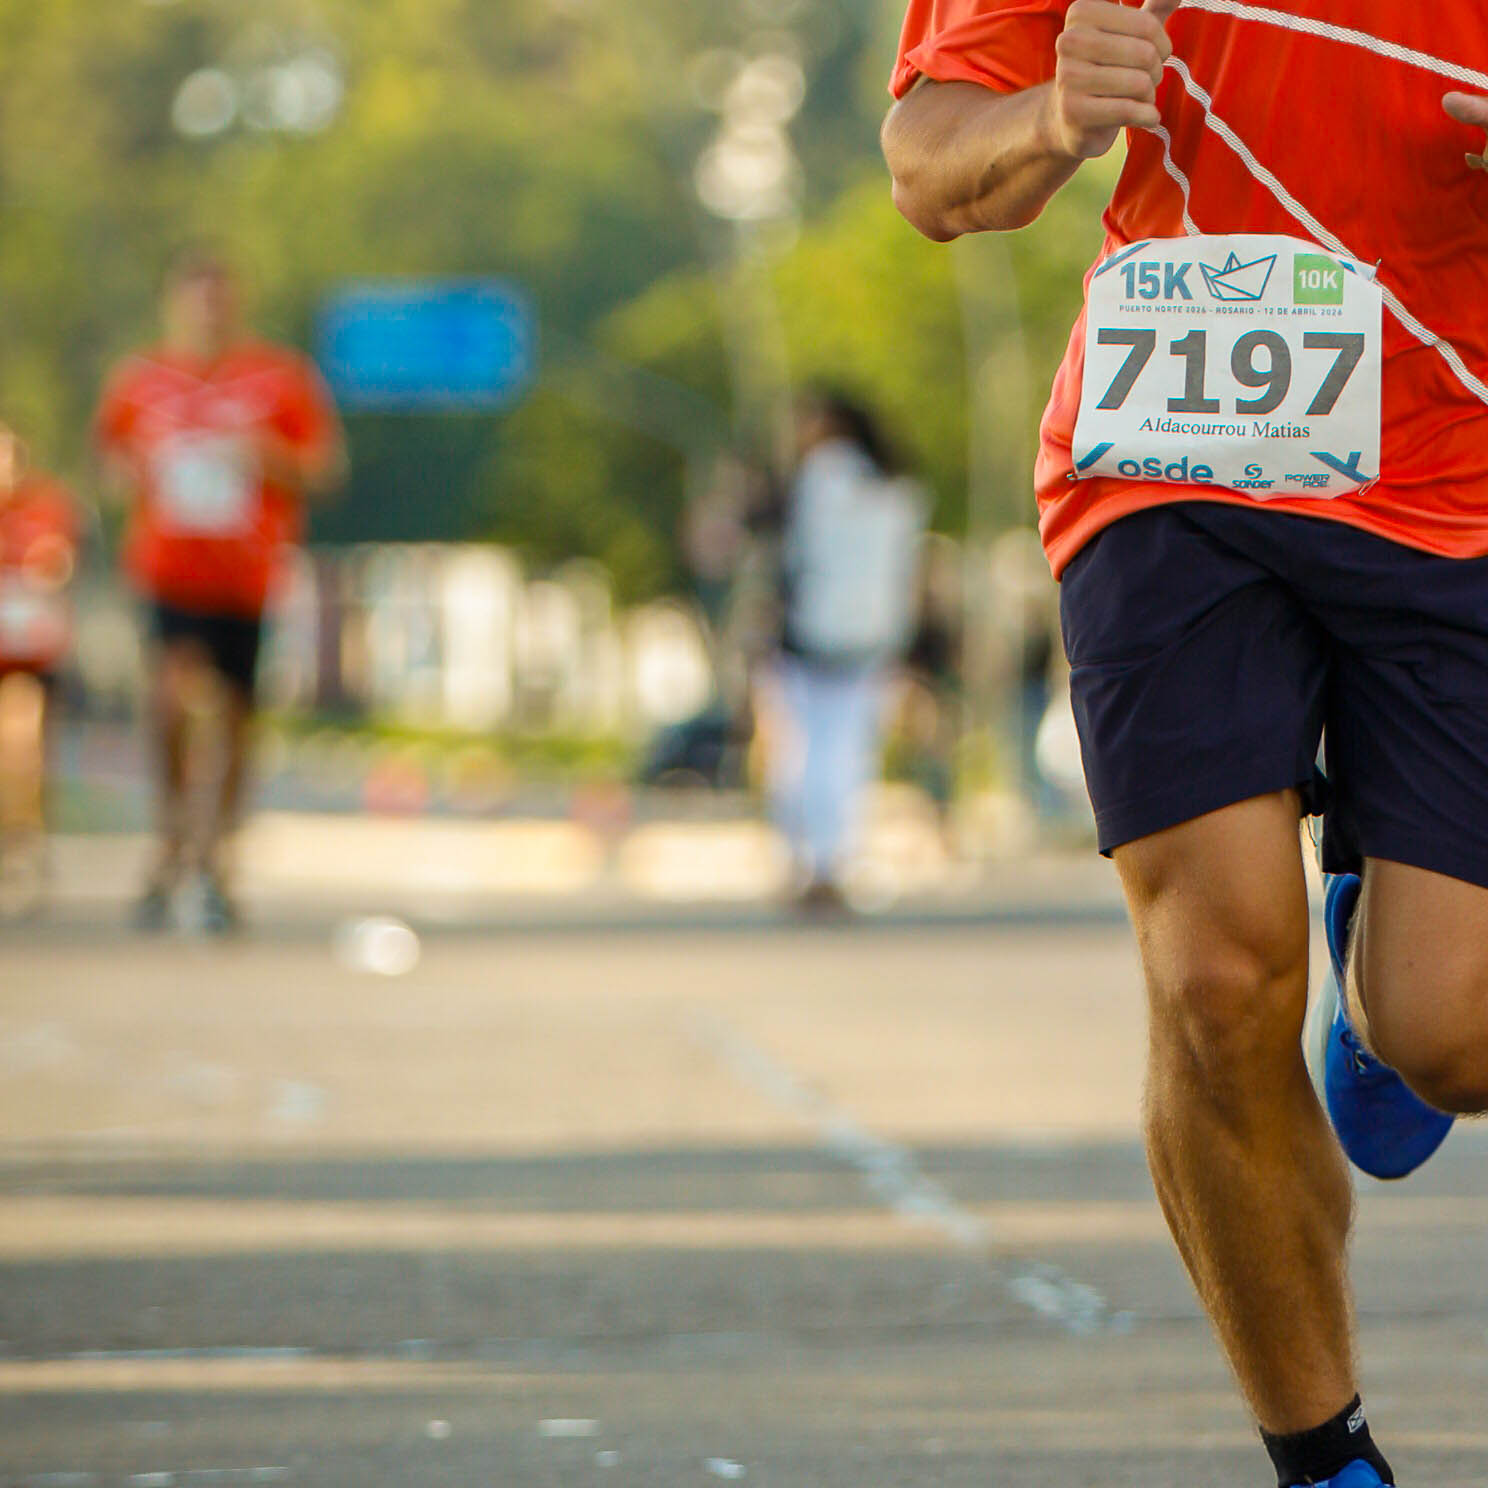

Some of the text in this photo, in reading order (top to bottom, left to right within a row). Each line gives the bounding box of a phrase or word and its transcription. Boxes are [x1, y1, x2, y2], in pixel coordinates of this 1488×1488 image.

[1119, 261, 1193, 300] 15K
[1298, 269, 1338, 290] 10K
[1119, 304, 1152, 313] PUERTO
[1155, 304, 1184, 314] NORTE
[1215, 306, 1254, 315] ROSARIO
[1264, 307, 1274, 315] 12
[1277, 307, 1289, 316] DE
[1291, 307, 1317, 316] ABRIL
[1095, 327, 1365, 416] 7197
[1138, 417, 1311, 438] Aldacourrou Matias
[1117, 455, 1214, 484] osde
